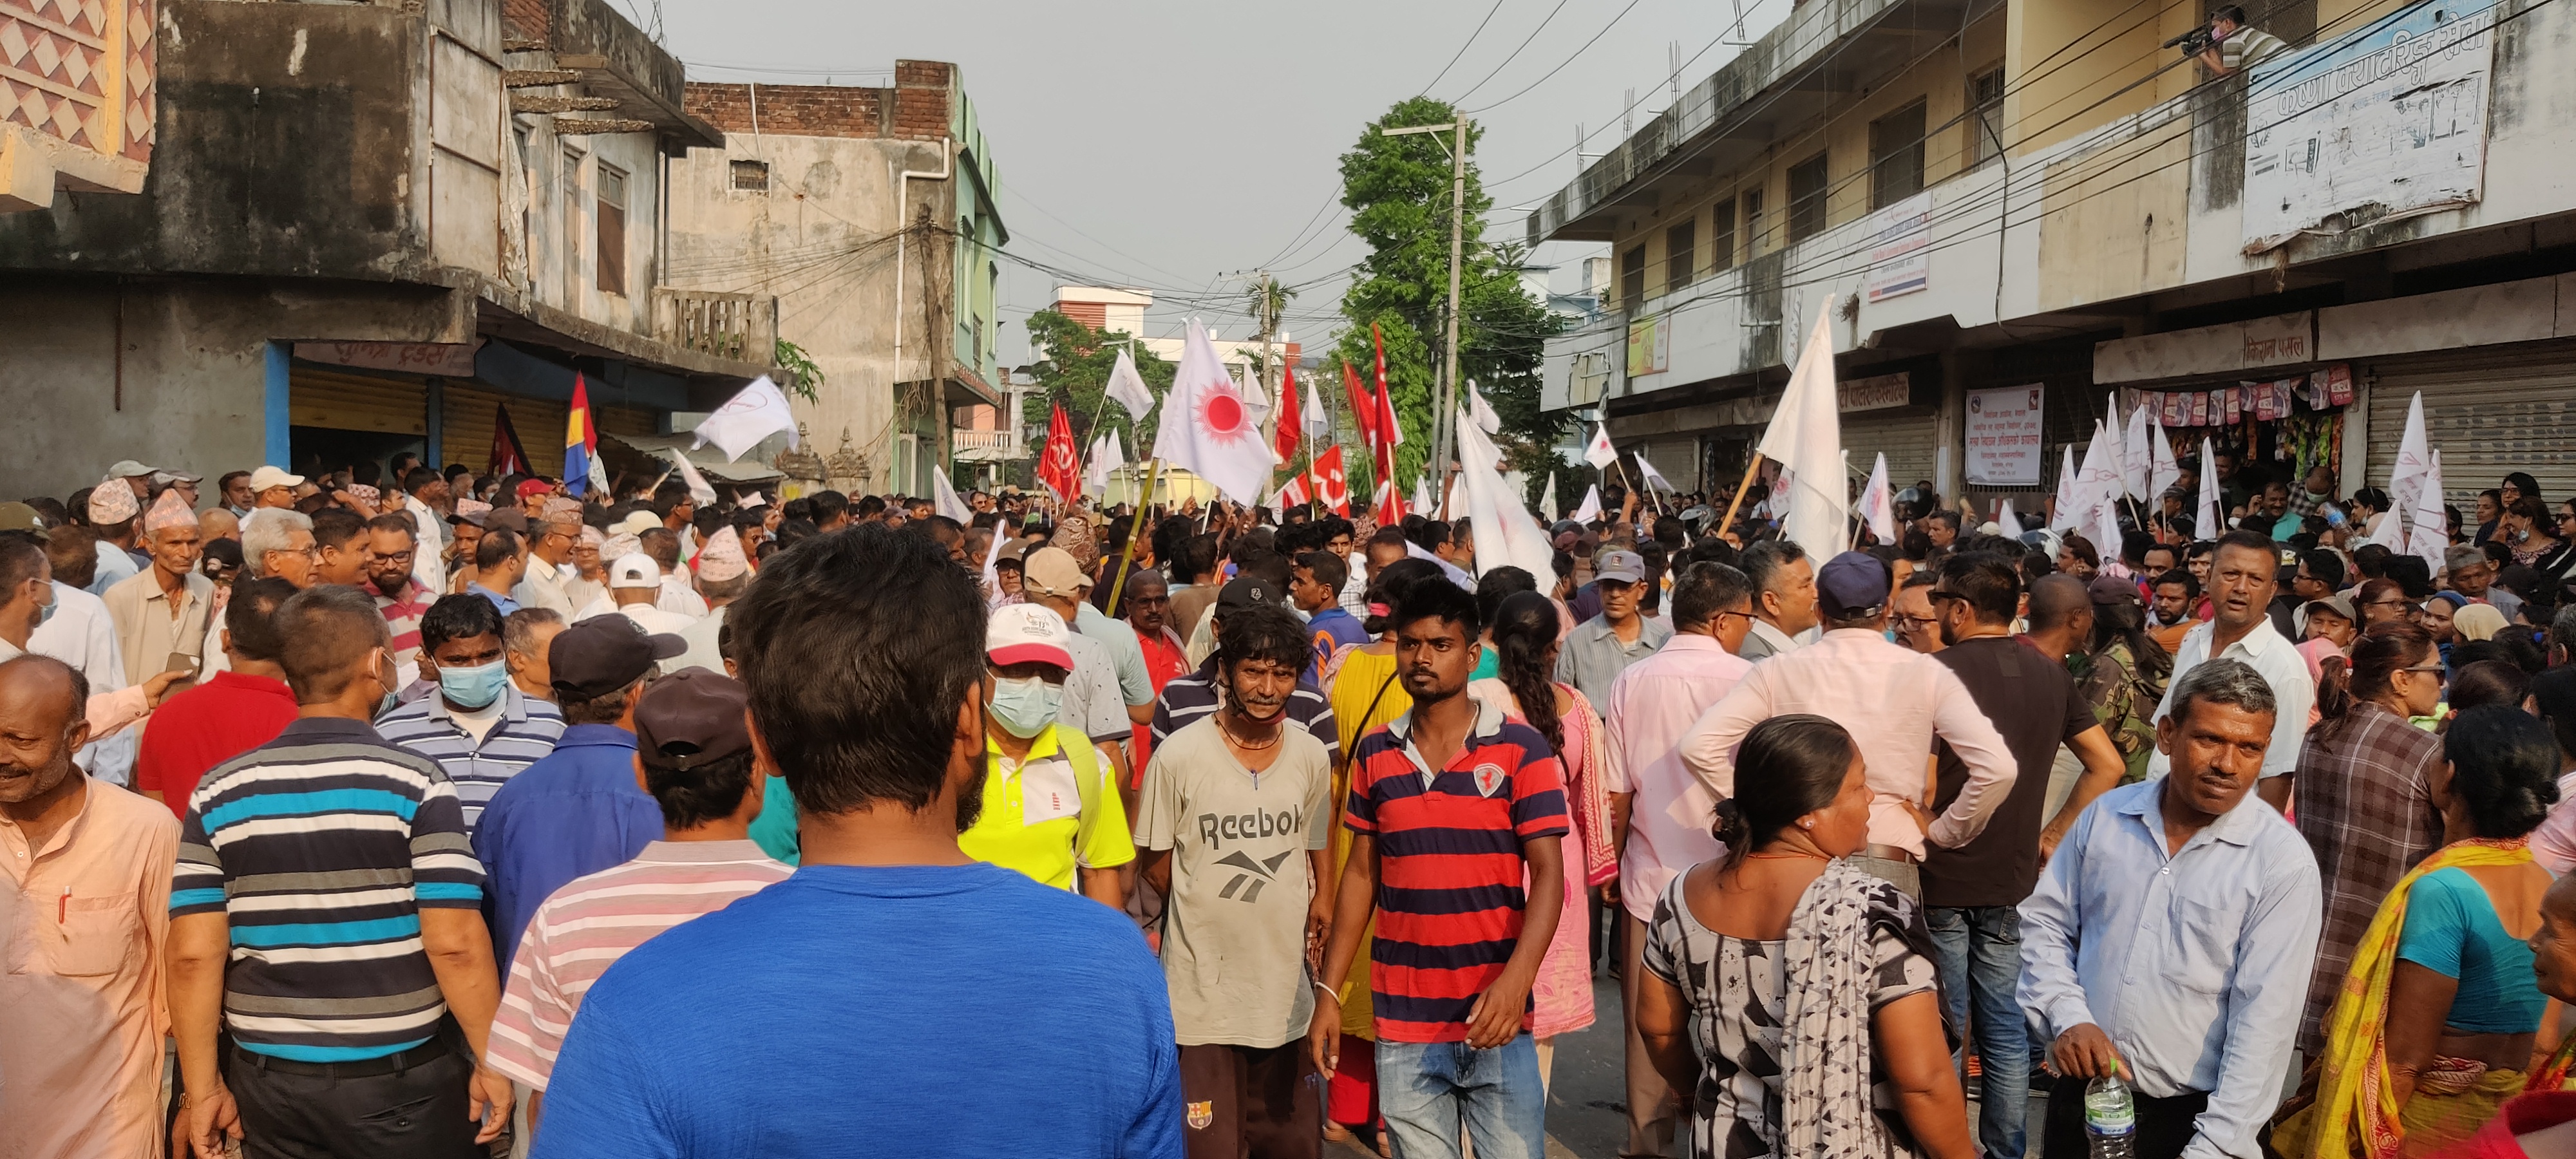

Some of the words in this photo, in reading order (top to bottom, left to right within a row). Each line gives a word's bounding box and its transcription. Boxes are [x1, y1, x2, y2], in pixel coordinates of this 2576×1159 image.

[2278, 68, 2332, 122] कृष्णा
[2439, 10, 2489, 61] सेवा
[1198, 804, 1303, 850] Reebok
